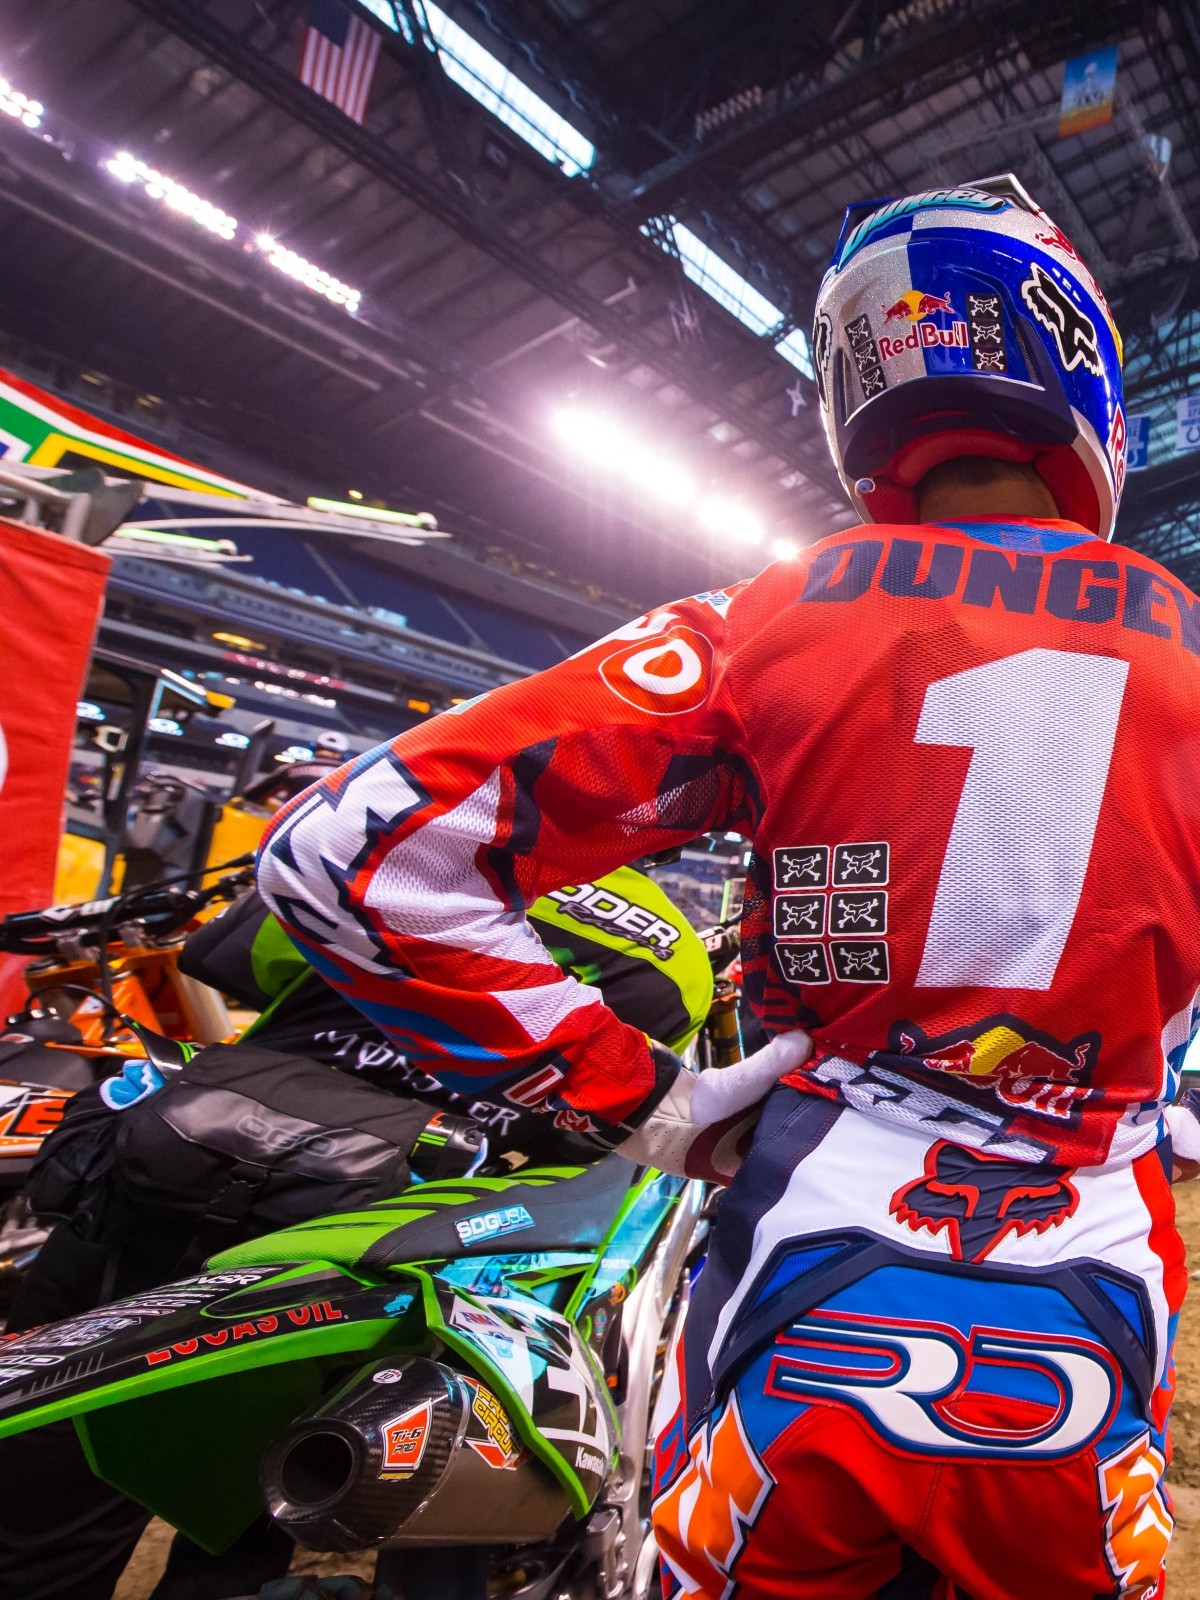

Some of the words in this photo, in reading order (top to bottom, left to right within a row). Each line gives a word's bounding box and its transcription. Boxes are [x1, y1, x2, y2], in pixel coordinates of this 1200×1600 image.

[878, 324, 920, 362] Red
[920, 322, 969, 348] Bull
[913, 648, 1130, 991] 1
[547, 883, 682, 949] DDER
[145, 1315, 278, 1365] LUCAS
[286, 1301, 341, 1325] OIL
[391, 1427, 424, 1443] Ti-6
